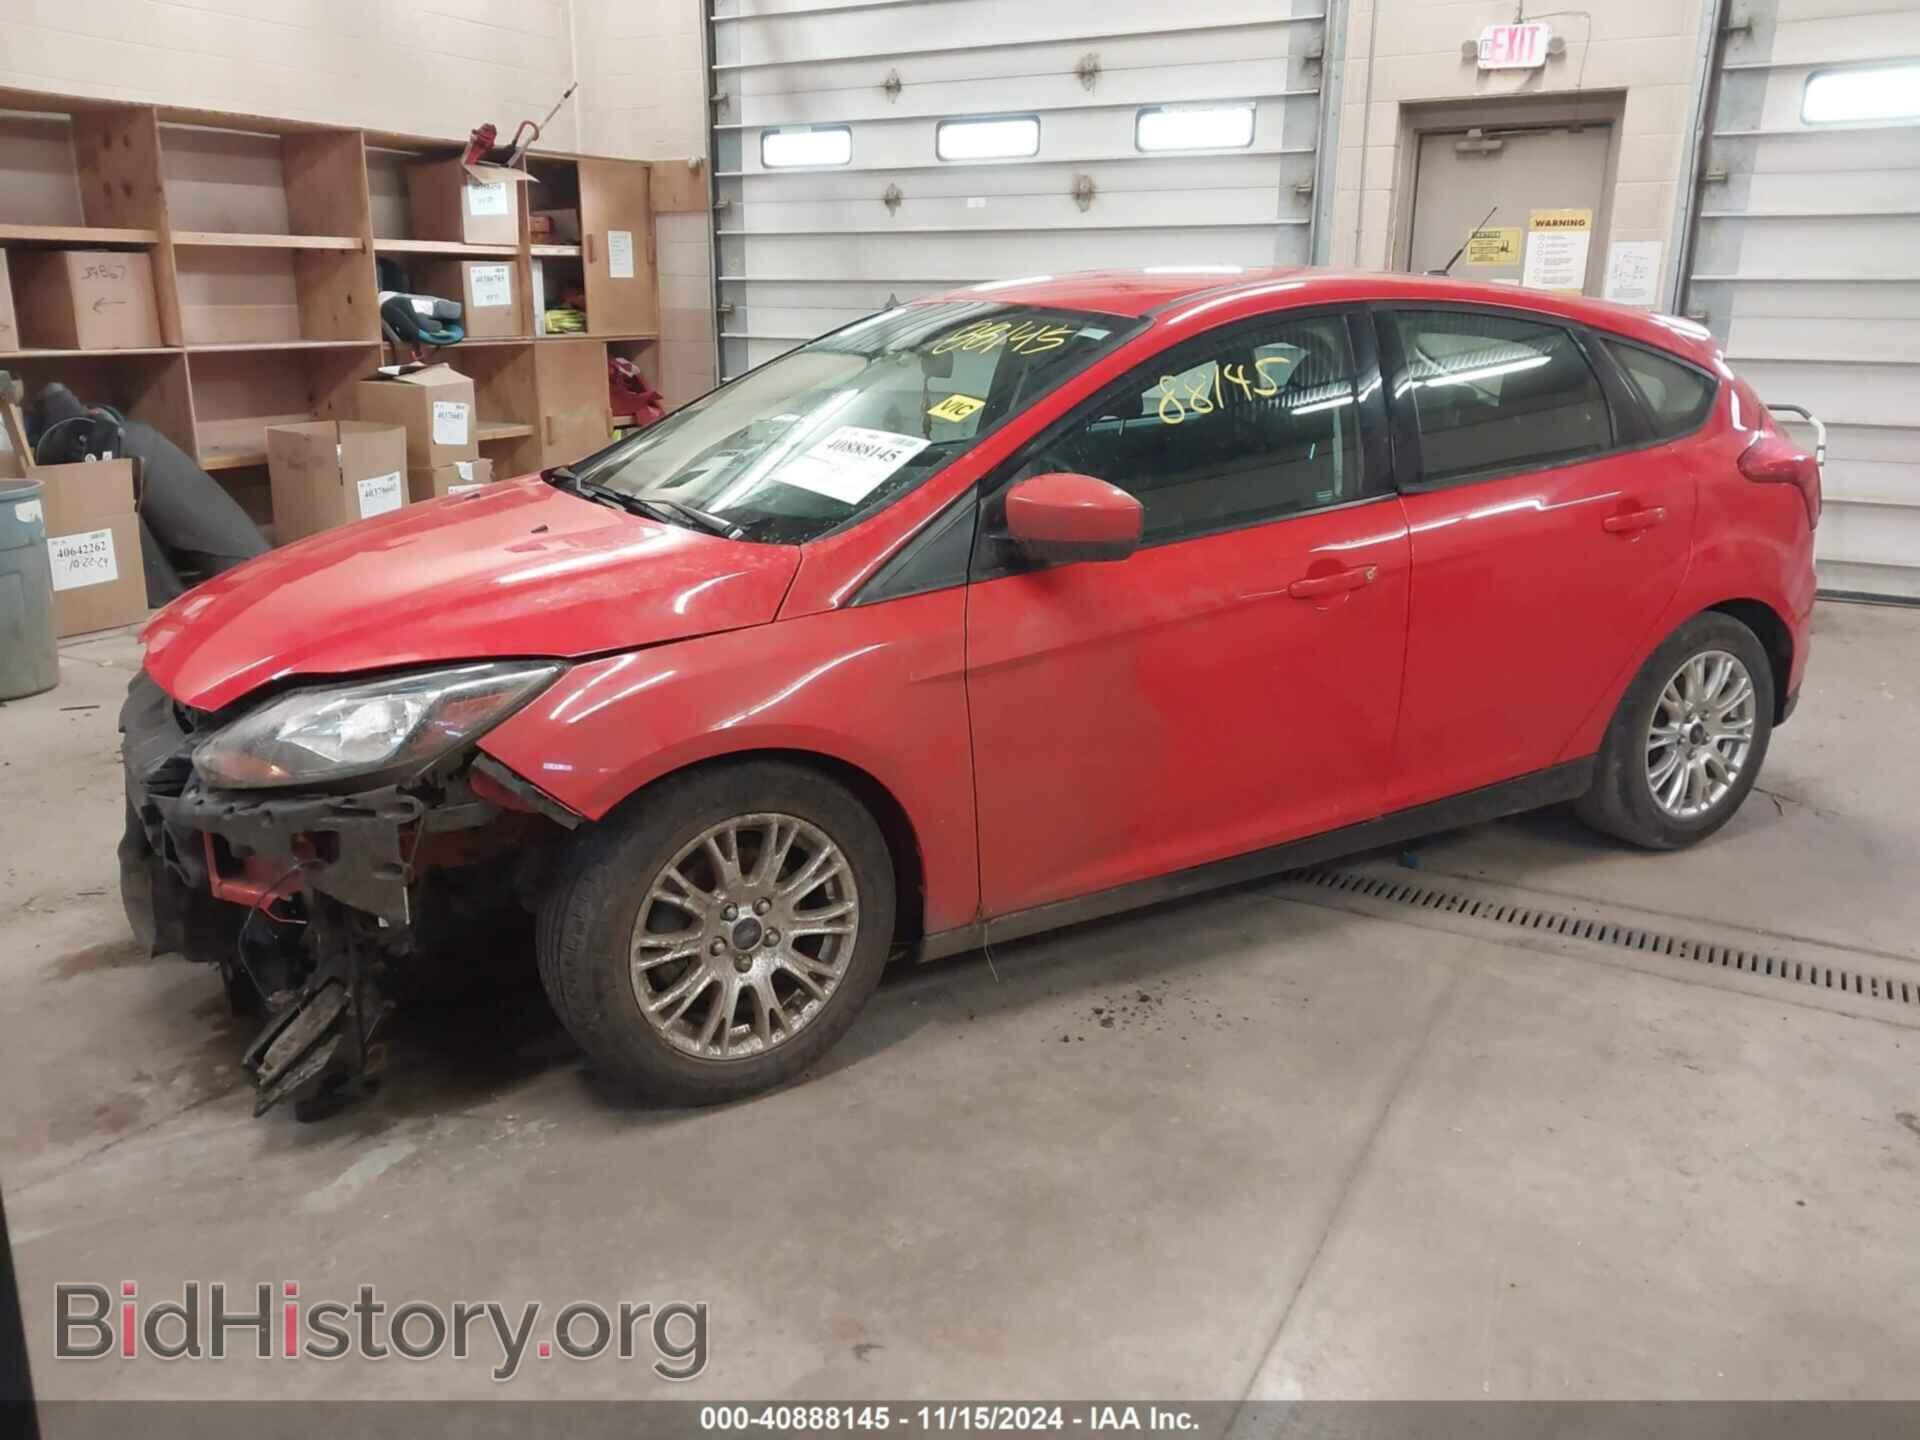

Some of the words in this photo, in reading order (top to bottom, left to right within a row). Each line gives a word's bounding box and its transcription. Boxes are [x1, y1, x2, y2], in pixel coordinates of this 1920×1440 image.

[1491, 27, 1540, 64] EXIT
[1536, 219, 1585, 227] WARNING
[1159, 357, 1290, 424] 88145
[941, 400, 973, 416] VIC
[57, 541, 106, 558] 40642262
